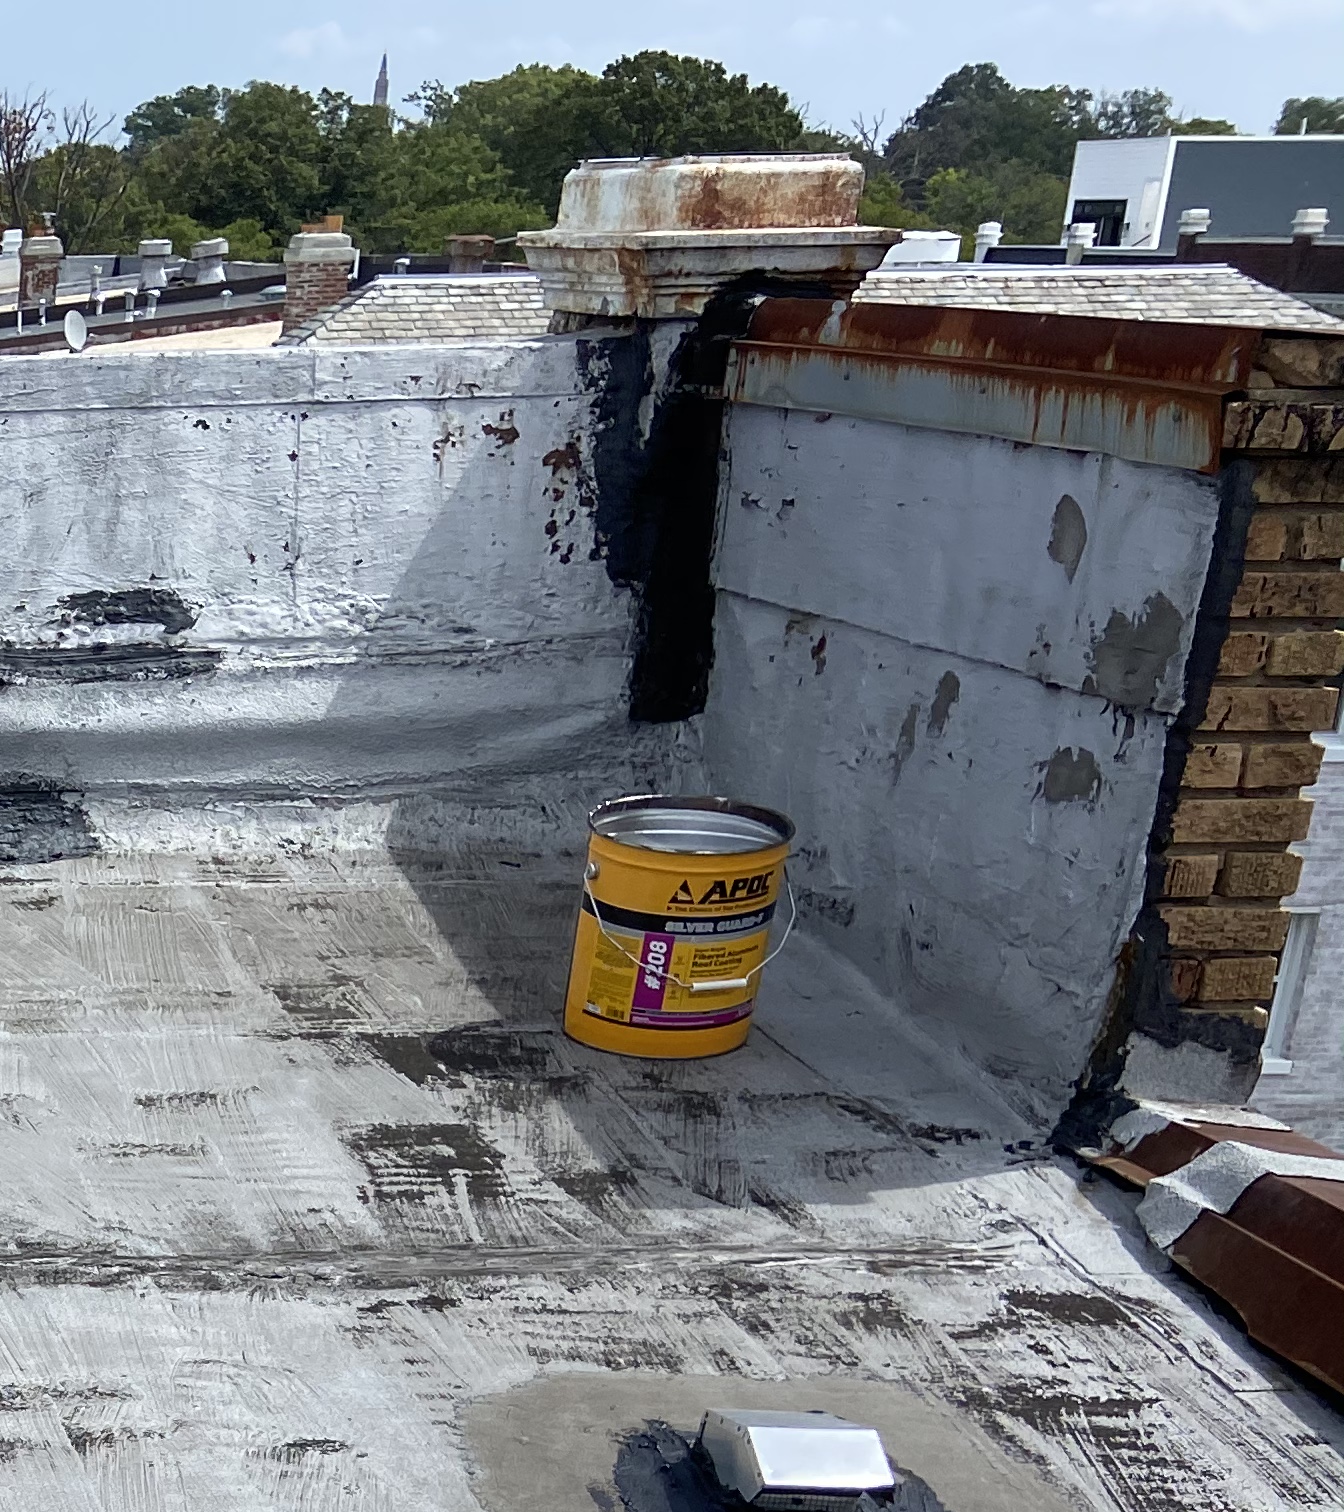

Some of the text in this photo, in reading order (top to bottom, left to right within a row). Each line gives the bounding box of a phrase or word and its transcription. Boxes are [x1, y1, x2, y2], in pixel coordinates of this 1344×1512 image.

[698, 870, 774, 905] APOC
[665, 921, 714, 933] SILVER
[644, 940, 667, 990] #208
